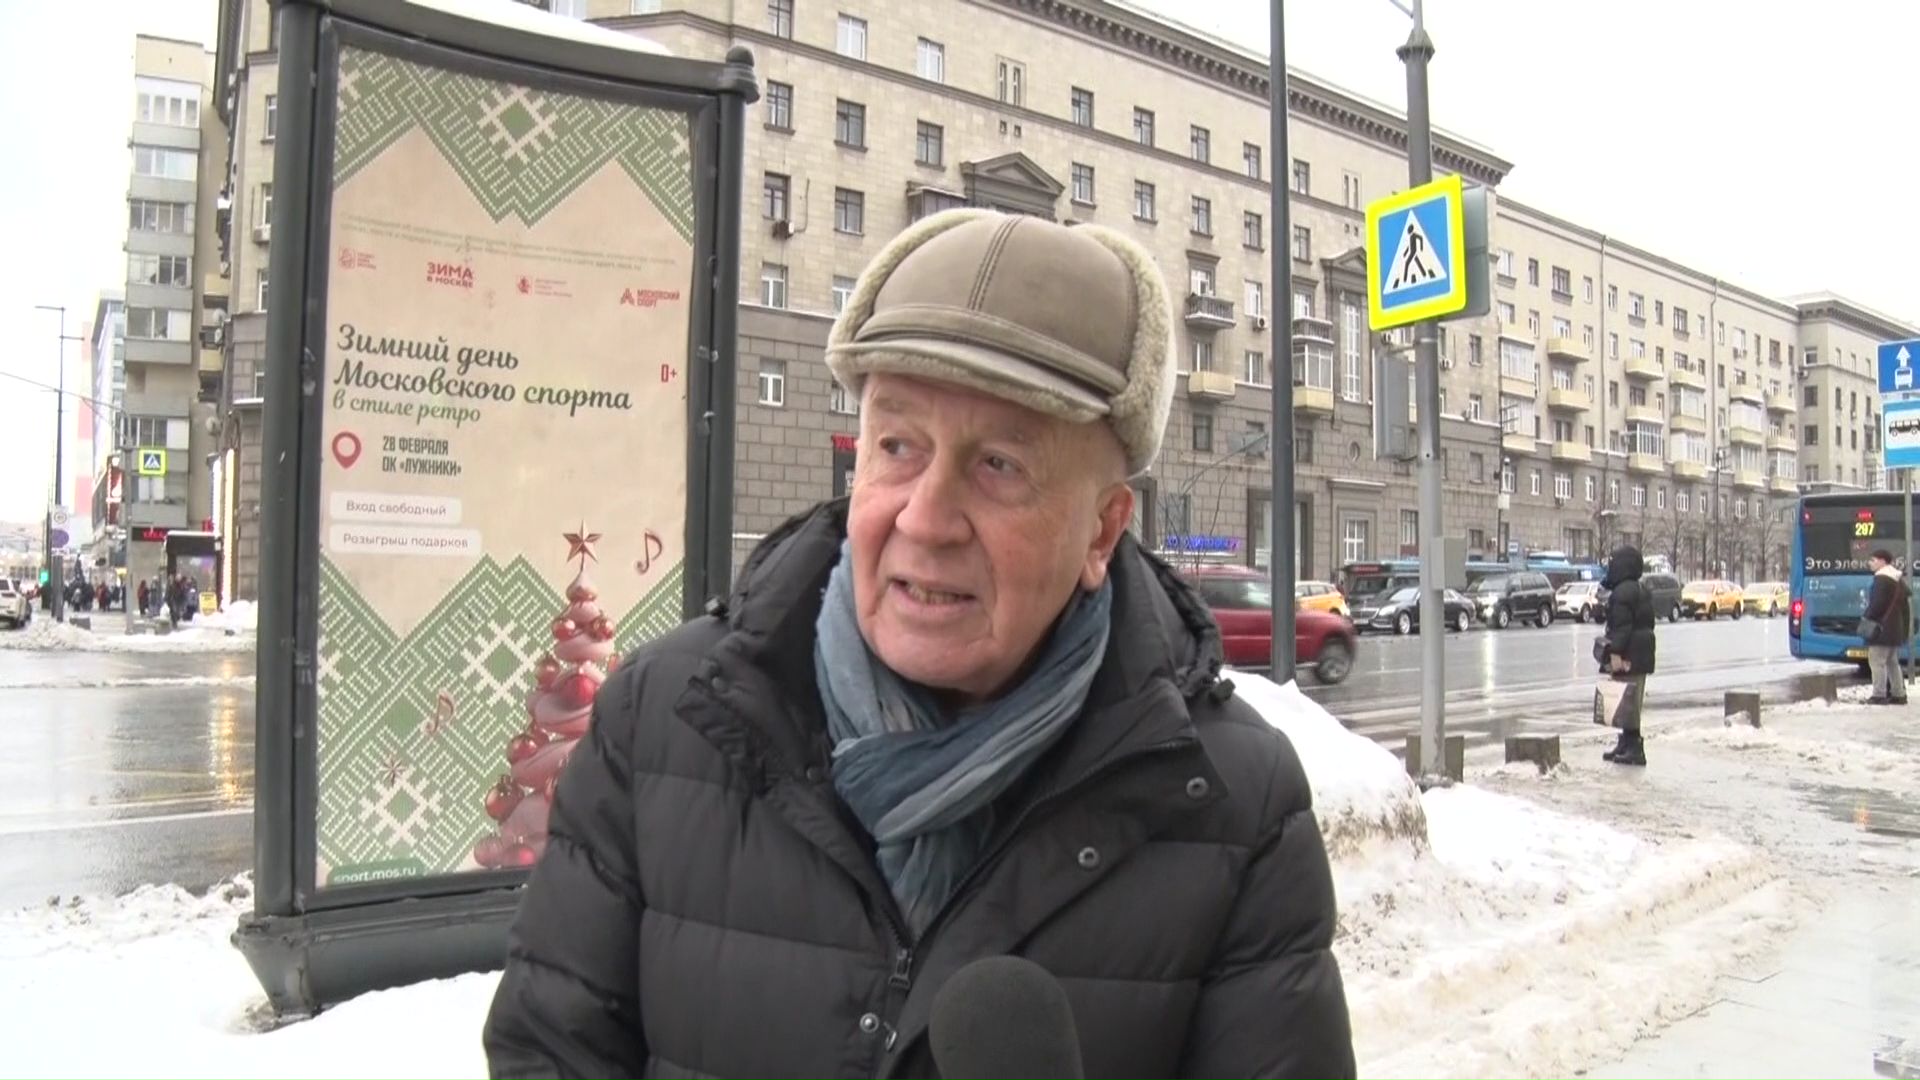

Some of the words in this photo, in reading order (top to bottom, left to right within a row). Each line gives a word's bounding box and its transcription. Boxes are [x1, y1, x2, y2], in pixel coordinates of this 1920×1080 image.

[427, 262, 474, 280] ЗИМА
[435, 277, 474, 289] МОСКВЕ
[337, 323, 450, 363] Зимний
[457, 346, 519, 376] день
[661, 364, 678, 383] 0+
[333, 358, 516, 402] Московского
[524, 385, 633, 417] спорта
[332, 388, 346, 410] в
[350, 396, 413, 417] стиле
[416, 403, 481, 429] ретро
[398, 437, 449, 455] ФЕВРАЛЯ
[382, 456, 397, 472] ОК
[400, 457, 462, 477] «ЛУЖНИКИ»
[346, 500, 376, 514] Вход
[379, 502, 447, 516] свободный
[343, 533, 408, 547] Розыгрыш
[411, 537, 469, 549] подарков
[1805, 556, 1831, 570] Это
